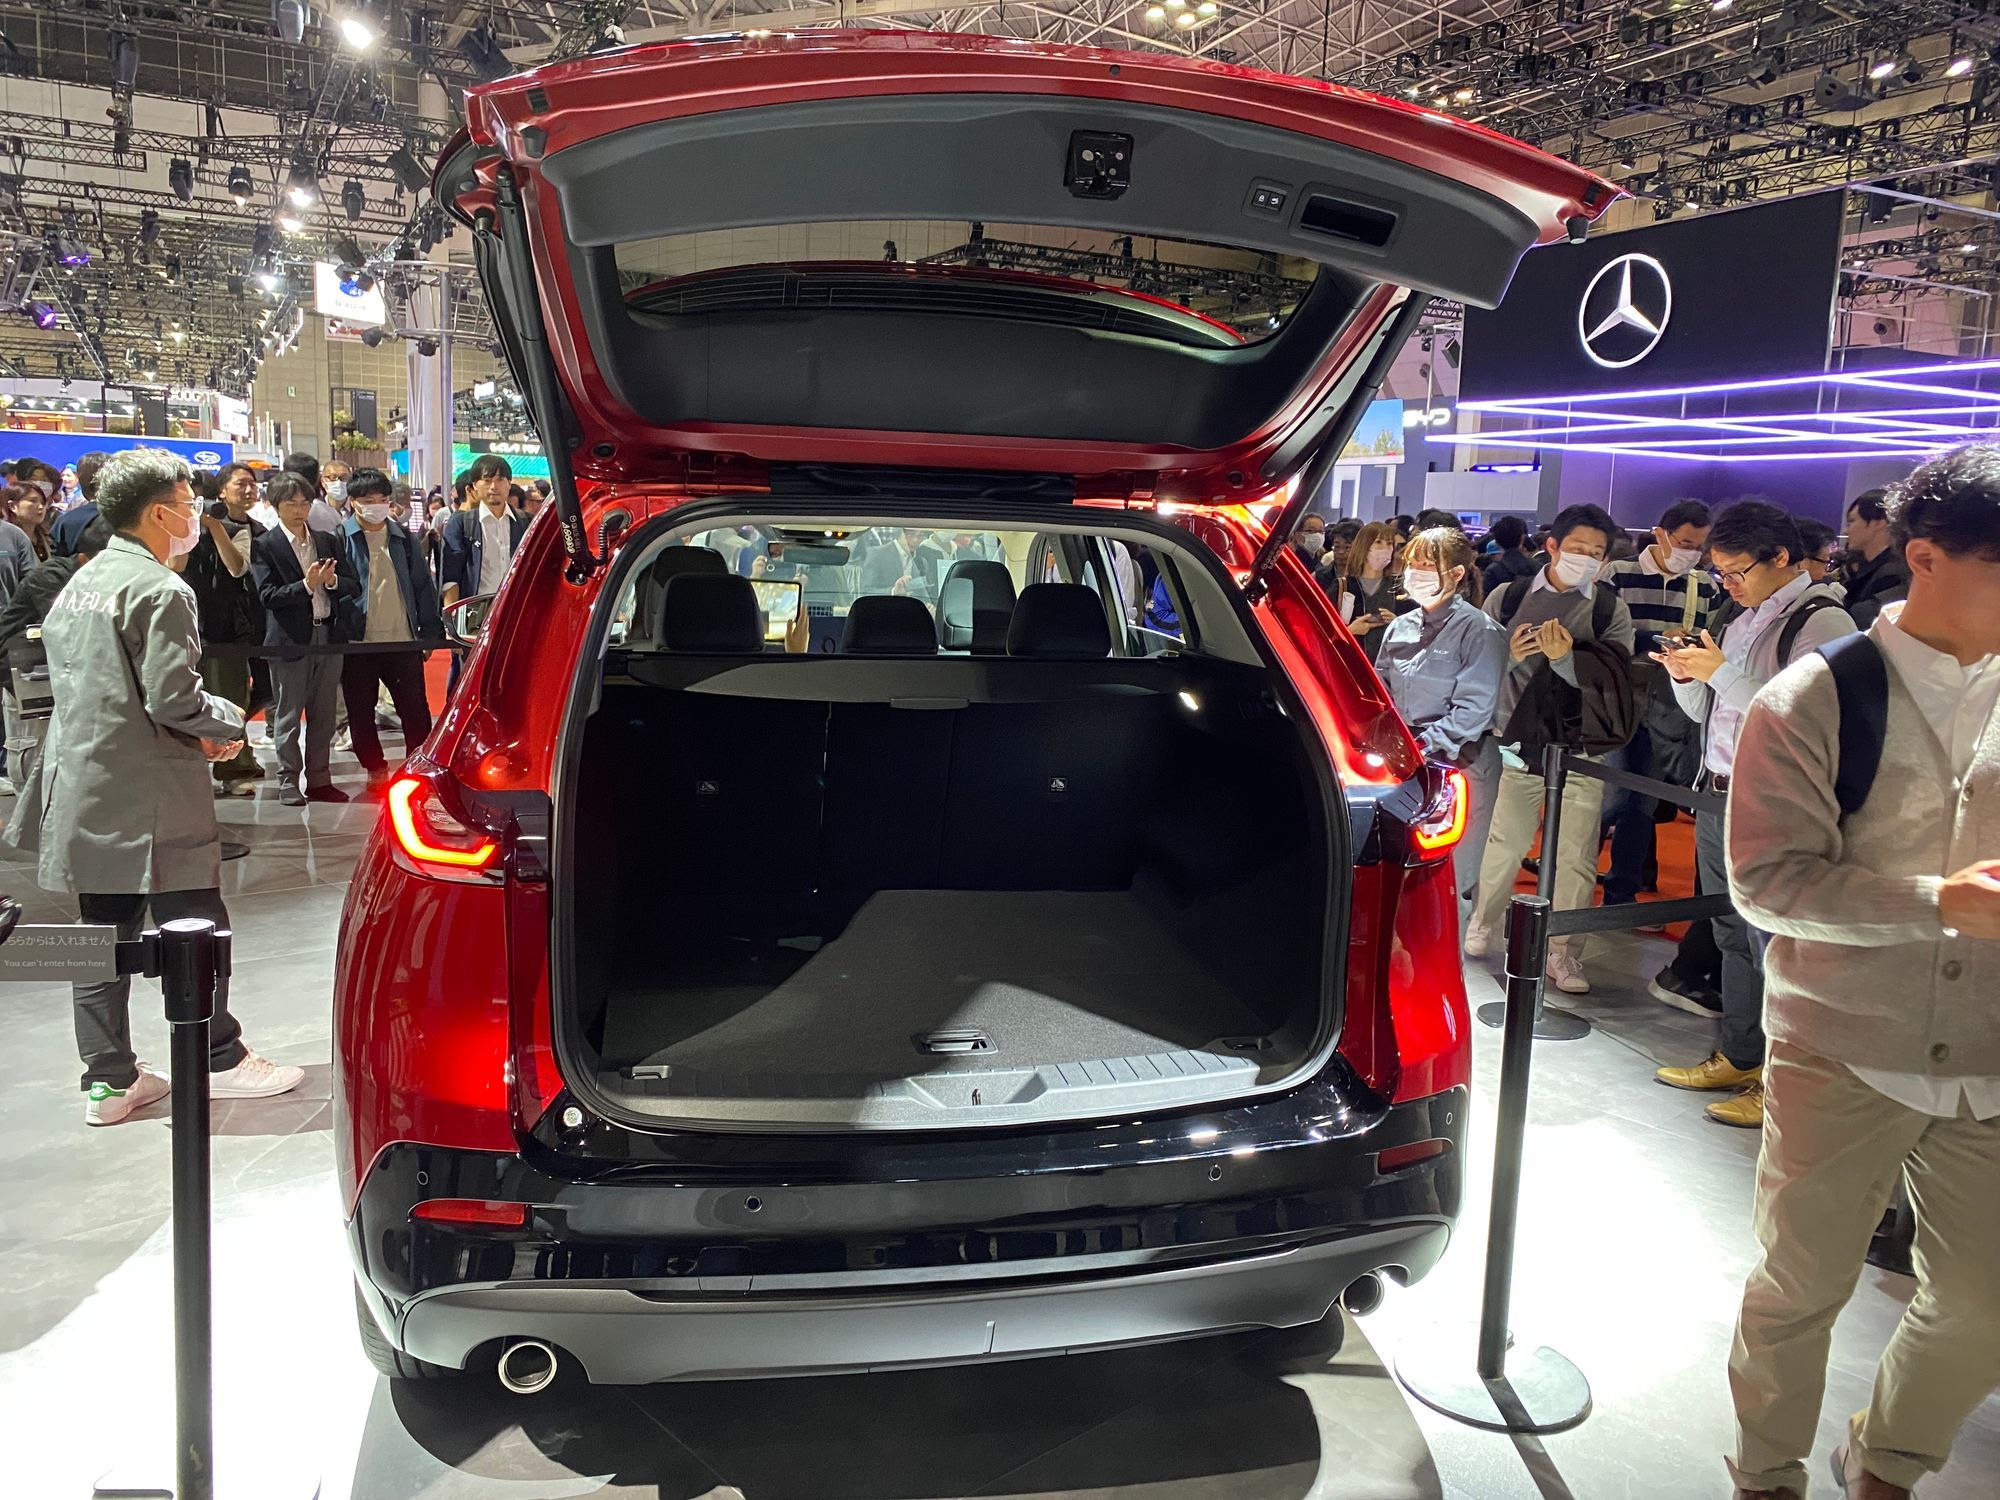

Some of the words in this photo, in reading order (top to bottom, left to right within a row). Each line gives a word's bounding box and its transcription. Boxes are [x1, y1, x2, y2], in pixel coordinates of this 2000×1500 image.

[4, 959, 20, 968] You
[21, 959, 42, 968] can't
[44, 960, 65, 968] enter
[67, 959, 87, 968] from
[88, 959, 107, 968] here
